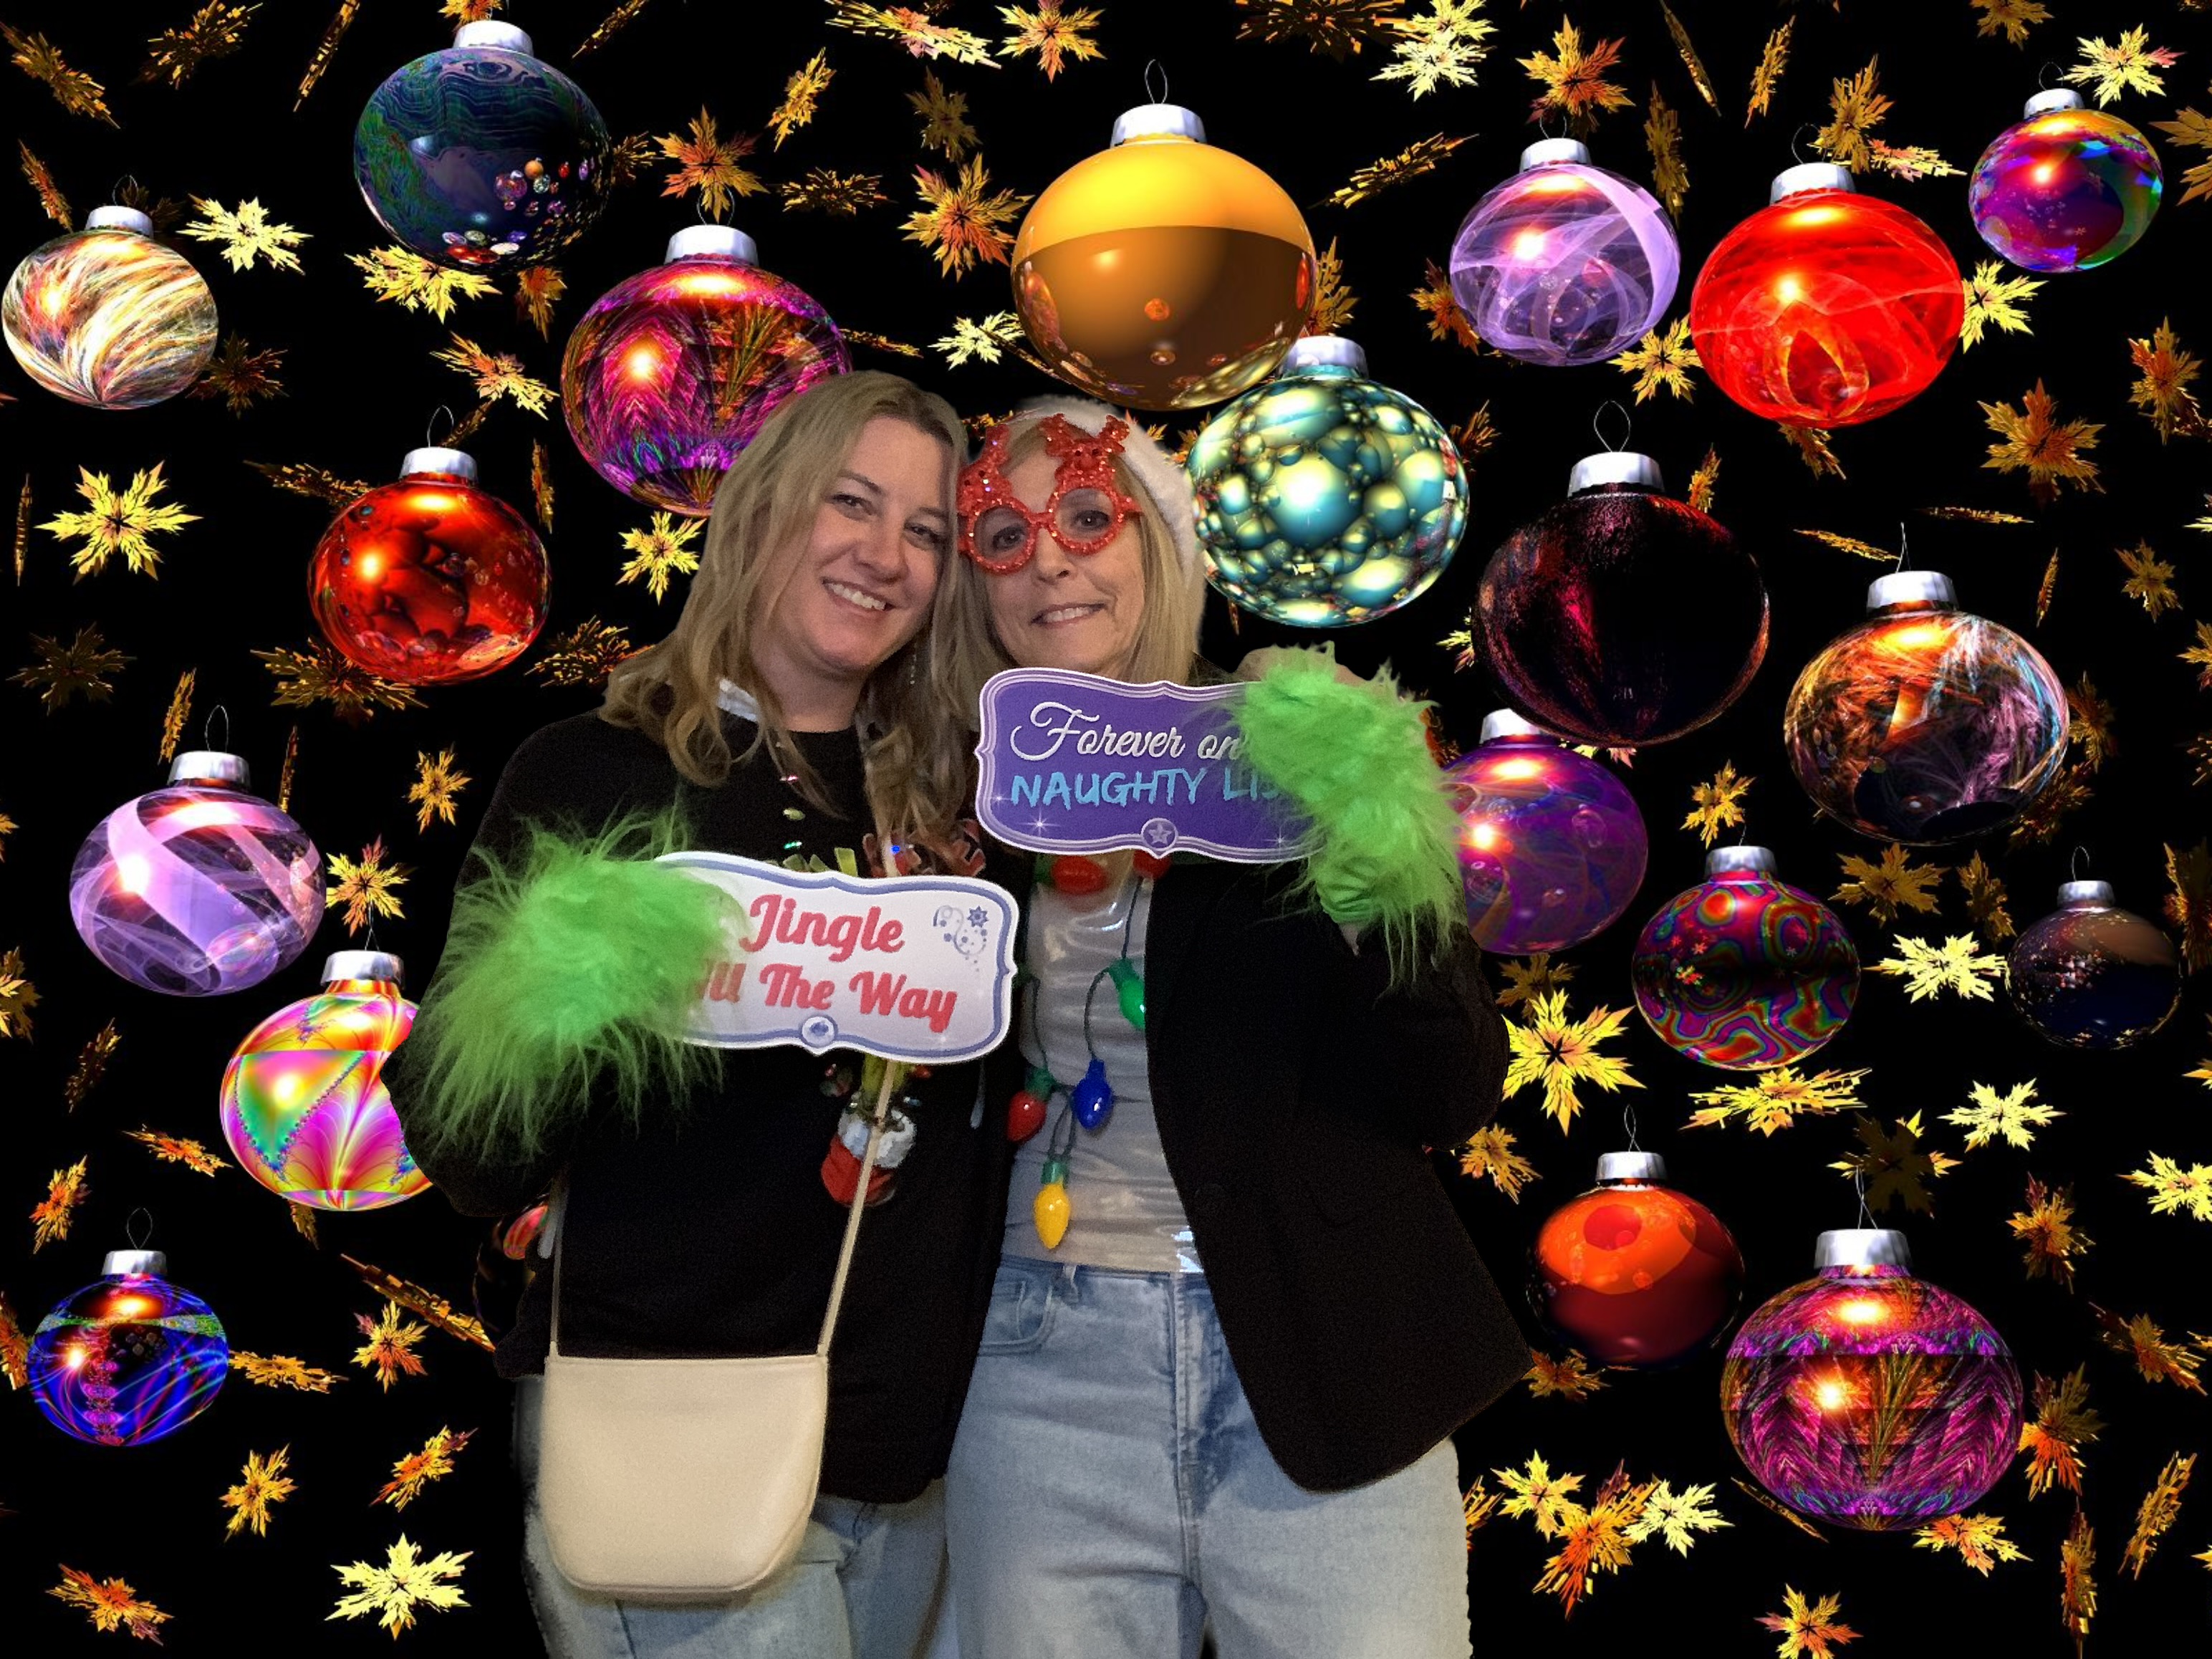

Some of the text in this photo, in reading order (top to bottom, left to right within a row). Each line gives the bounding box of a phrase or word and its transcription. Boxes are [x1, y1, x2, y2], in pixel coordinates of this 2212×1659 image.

[1010, 701, 1186, 761] Forever
[1010, 767, 1208, 811] NAUGHTY
[739, 894, 906, 963] Jingle
[759, 962, 836, 1011] The
[848, 970, 958, 1034] Way
